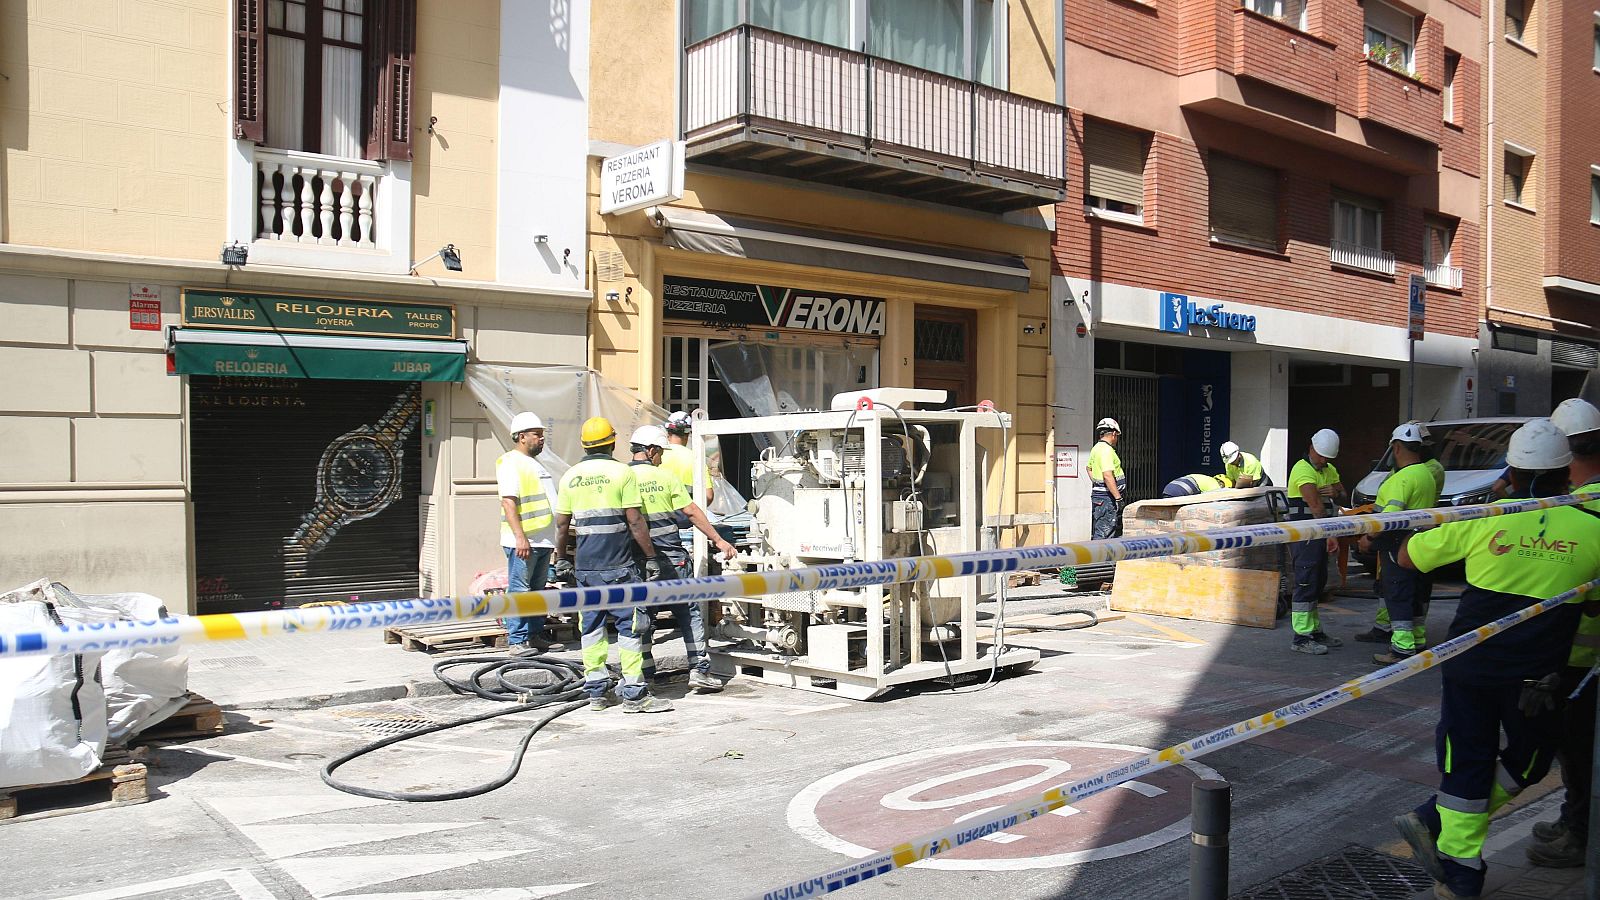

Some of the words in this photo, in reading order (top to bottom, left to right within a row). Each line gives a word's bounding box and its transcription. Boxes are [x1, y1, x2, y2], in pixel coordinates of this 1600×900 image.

[607, 146, 660, 172] RESTAURANT
[616, 166, 650, 186] PIZZERIA
[612, 181, 654, 205] VERONA
[663, 284, 757, 302] RESTAURANT
[131, 301, 159, 309] Alarma
[192, 305, 256, 320] JERSVALLES
[275, 302, 394, 319] RELOJERIA
[663, 299, 727, 314] PIZZERIA
[755, 285, 887, 337] VERONA
[315, 317, 355, 327] JOYERIA
[405, 311, 443, 322] TALLER
[408, 321, 440, 329] PROPIO
[215, 360, 289, 375] RELOJERIA
[392, 361, 432, 374] JUBAR
[903, 357, 908, 366] 3
[1201, 416, 1211, 453] Sirena
[1201, 456, 1211, 466] la
[1519, 535, 1579, 554] LYMET
[1517, 549, 1544, 558] OBRA
[1549, 553, 1576, 564] CIVIL
